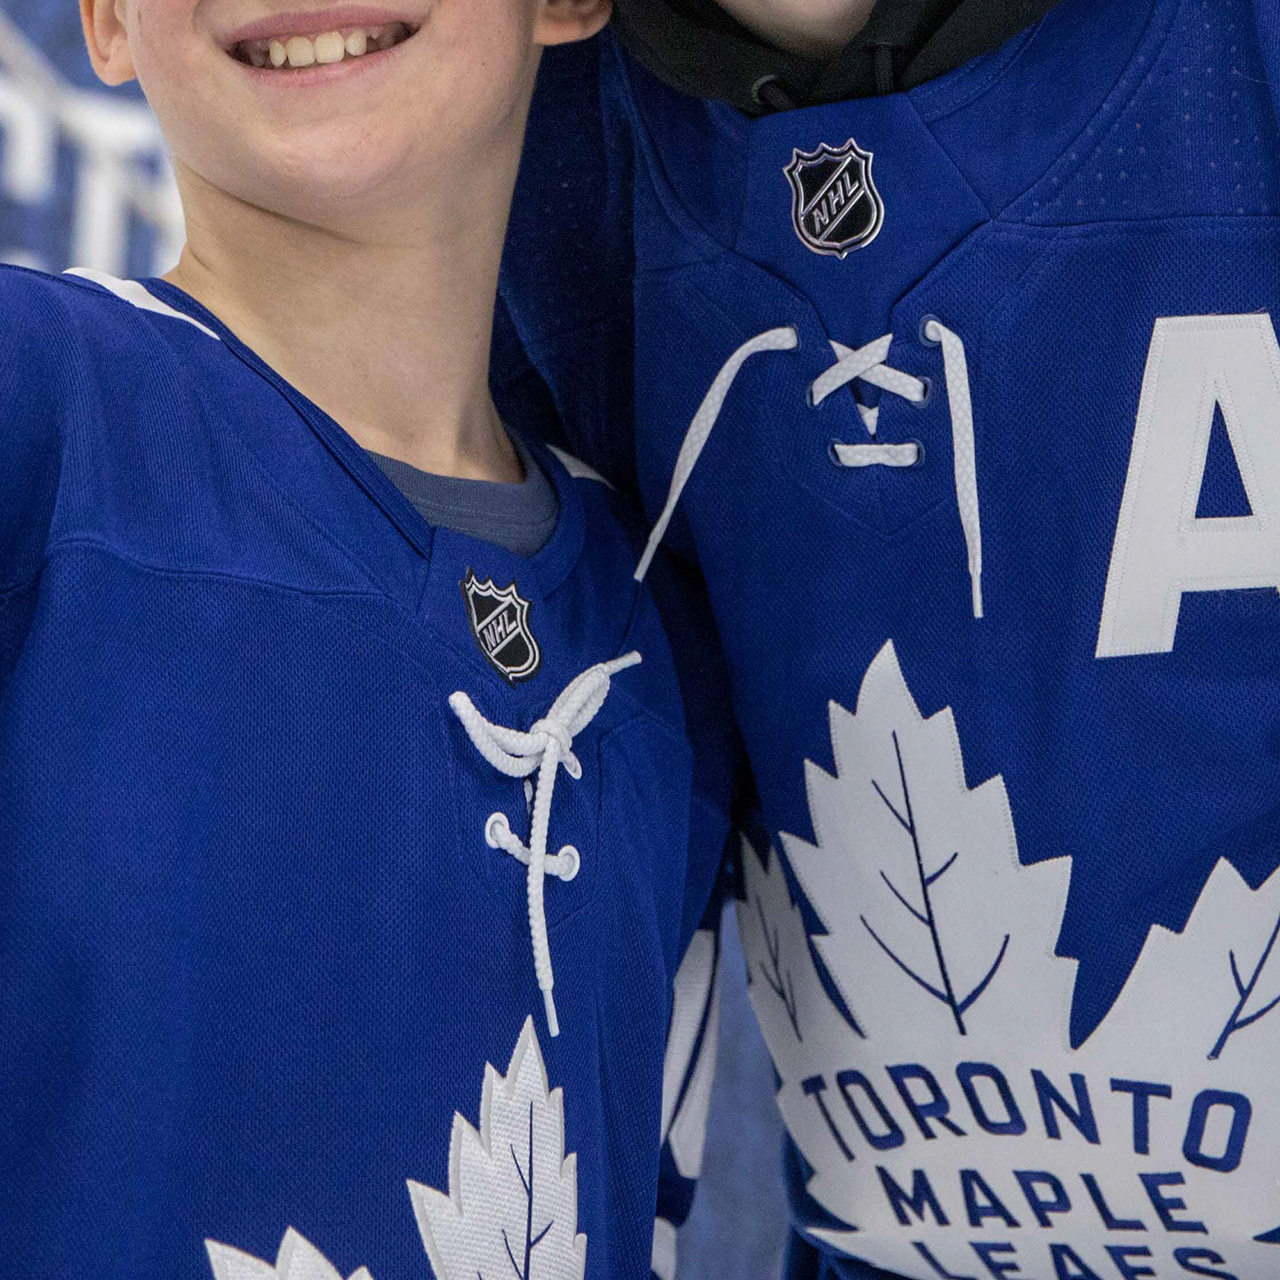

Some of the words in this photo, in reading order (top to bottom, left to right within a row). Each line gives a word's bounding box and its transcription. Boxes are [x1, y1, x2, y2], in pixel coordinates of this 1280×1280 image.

[812, 171, 860, 235] NHL
[482, 609, 518, 652] NHL
[800, 1060, 1253, 1175] TORONTO
[874, 1165, 1209, 1235] MAPLE
